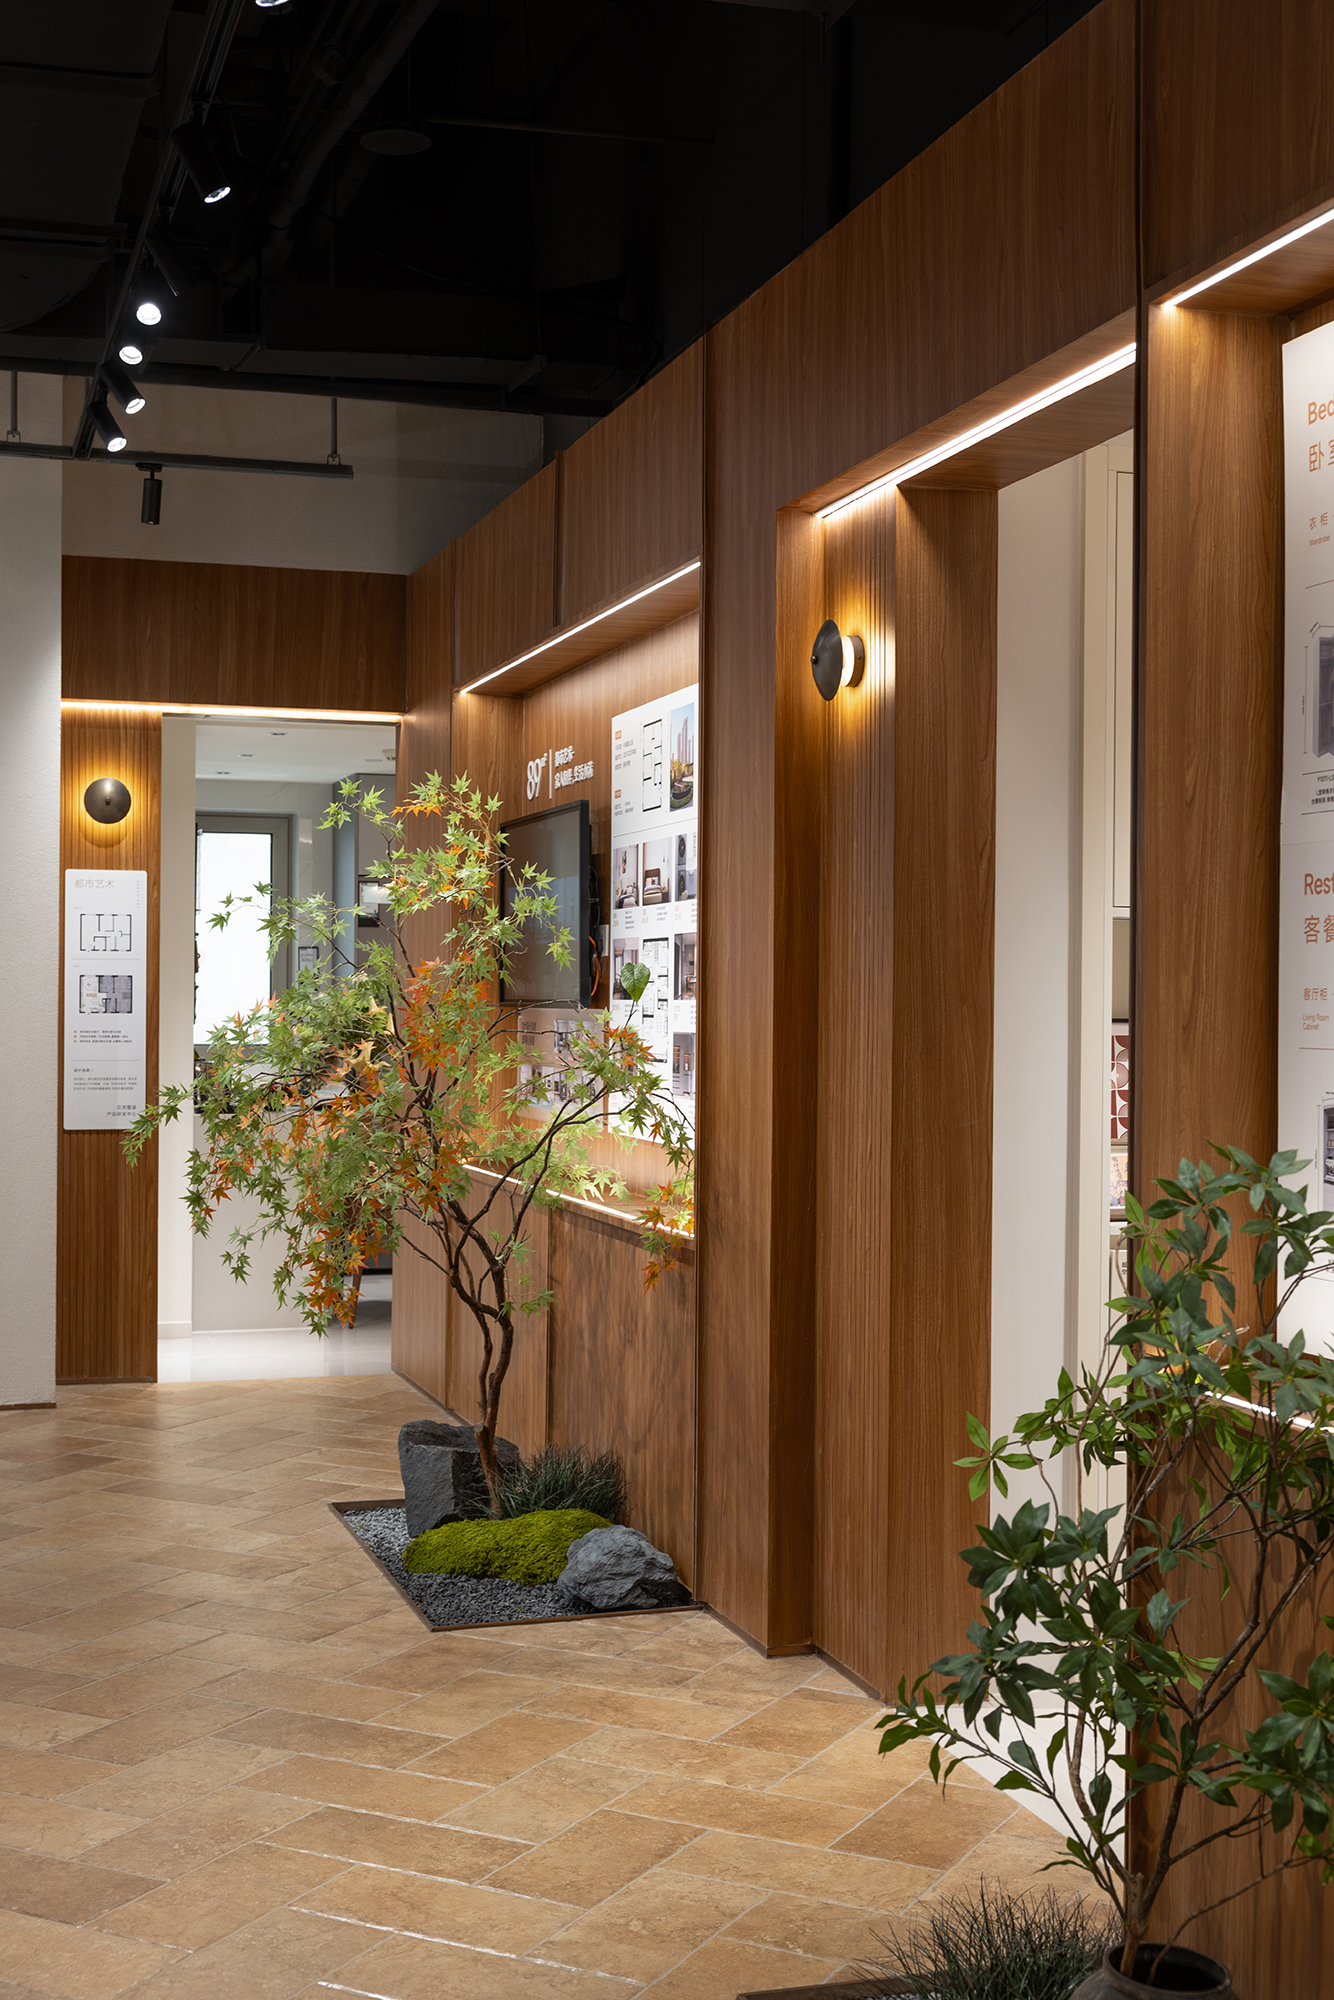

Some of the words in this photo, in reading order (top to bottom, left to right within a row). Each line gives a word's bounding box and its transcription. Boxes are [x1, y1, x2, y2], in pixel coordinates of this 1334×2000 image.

[1309, 512, 1328, 530] 衣柜
[1309, 535, 1331, 546] Wardrobe
[75, 879, 114, 888] 都市艺术
[1303, 987, 1328, 1001] 客厅柜
[1303, 1013, 1315, 1023] Living
[1316, 1013, 1330, 1022] Room
[1303, 1022, 1320, 1031] Cabinet
